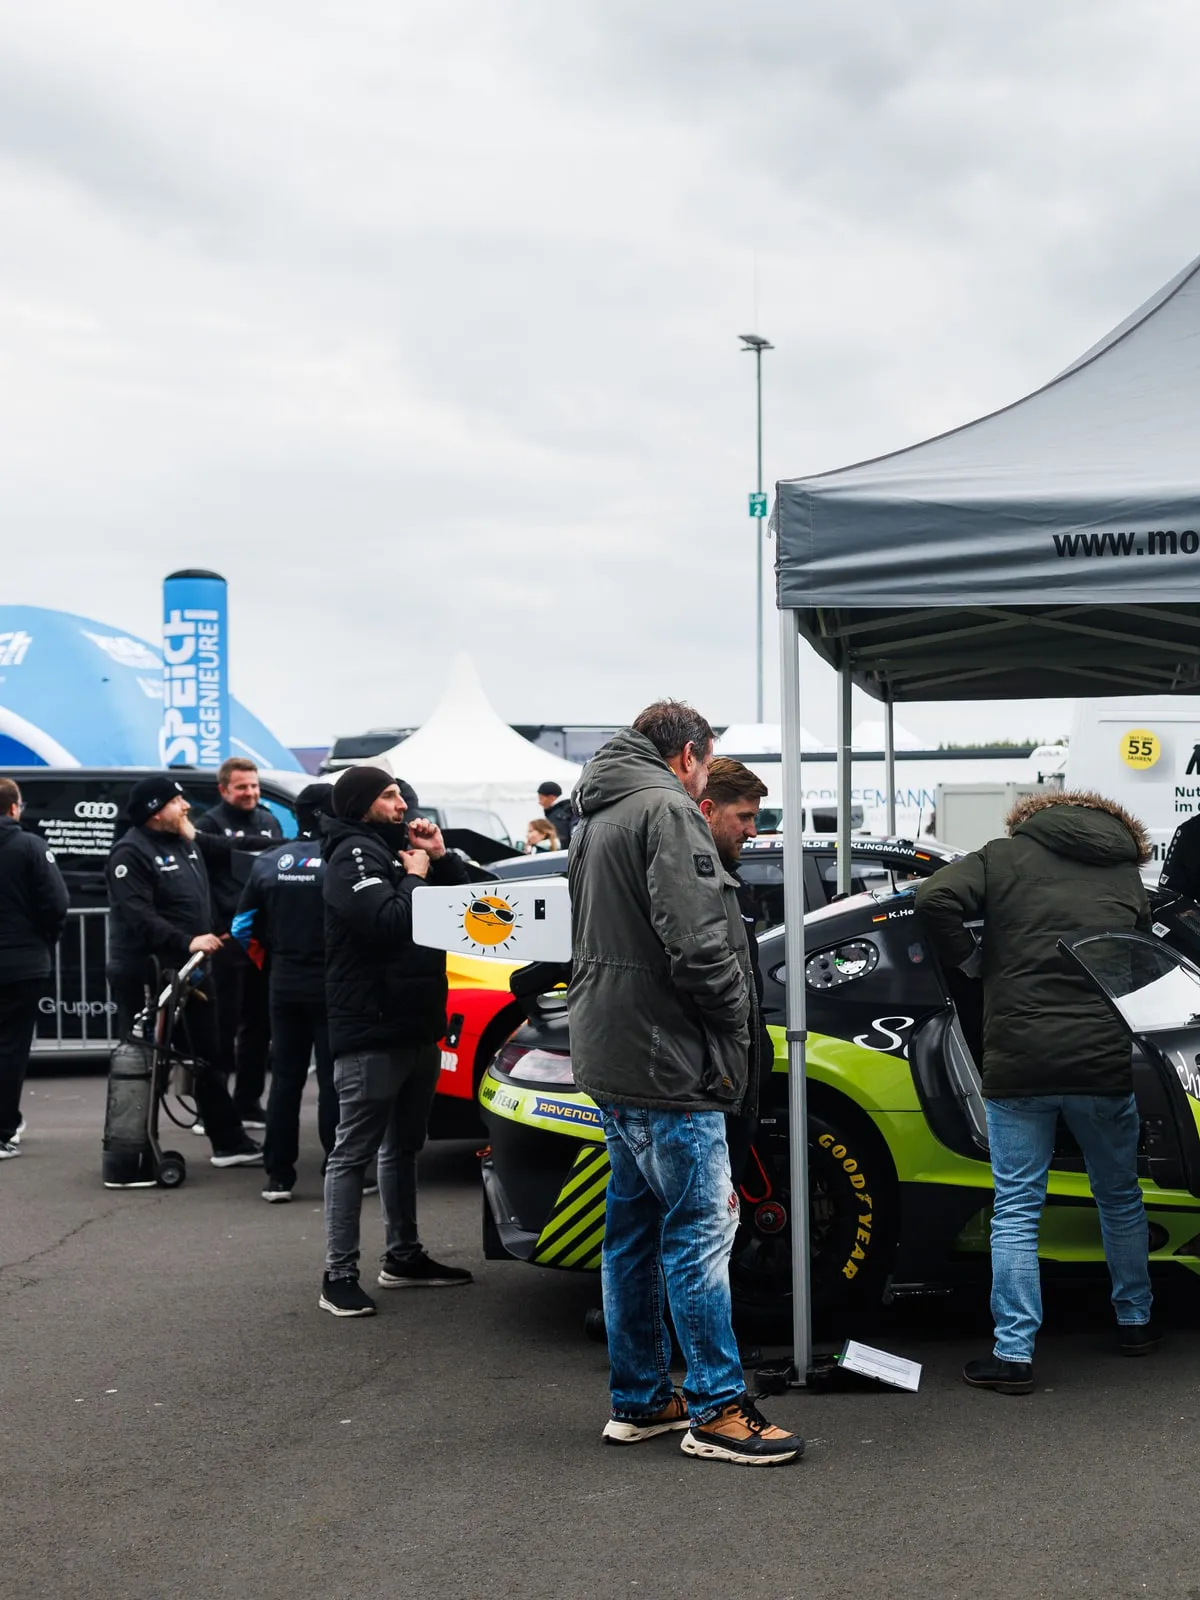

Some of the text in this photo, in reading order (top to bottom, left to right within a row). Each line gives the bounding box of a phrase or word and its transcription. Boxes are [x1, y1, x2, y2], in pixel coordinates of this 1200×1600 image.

[1128, 740, 1153, 756] 55
[1175, 801, 1193, 813] im
[277, 873, 316, 882] Motorsport
[38, 997, 118, 1017] Gruppe
[539, 1102, 601, 1124] RAVENOL
